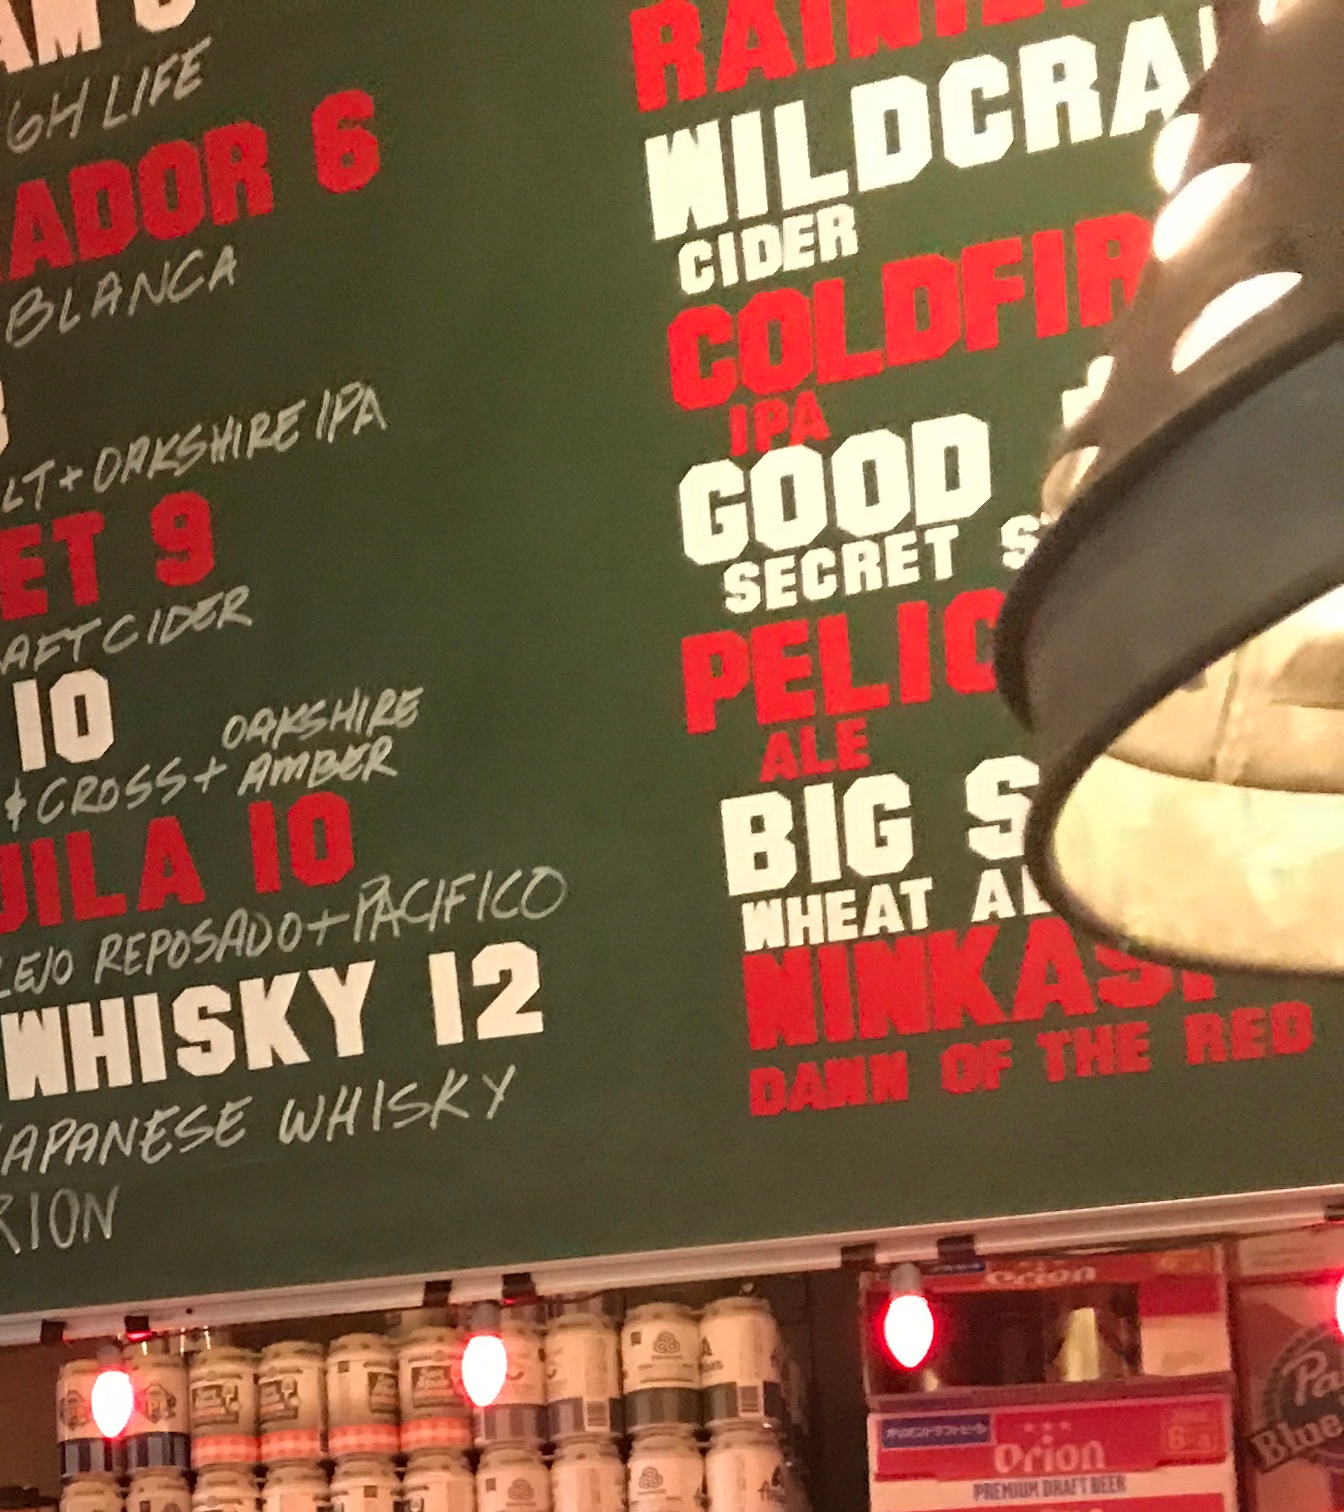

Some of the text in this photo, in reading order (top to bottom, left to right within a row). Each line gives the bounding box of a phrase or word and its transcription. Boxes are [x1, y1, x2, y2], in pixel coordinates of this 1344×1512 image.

[102, 37, 214, 133] LIFE
[312, 87, 380, 196] 6
[2, 244, 238, 348] BLANCA
[677, 203, 859, 296] CIDER
[666, 212, 1155, 412] COLDFIR
[92, 398, 309, 495] OAKSHIRE
[313, 379, 390, 445] IPA
[728, 390, 832, 457] IPA
[678, 412, 992, 566] GOOD
[148, 489, 218, 590] 9
[722, 523, 960, 615] SECRET
[101, 585, 255, 656] CIDER
[681, 587, 1007, 735] PELIC
[12, 668, 116, 774] 10
[221, 685, 425, 753] OAKSHIRE
[759, 717, 871, 783] ALE
[36, 756, 193, 825] CROSS
[237, 733, 400, 801] AMBER
[248, 790, 356, 896] 10
[720, 772, 914, 896] BIG
[93, 907, 309, 987] REPOSADO
[351, 864, 570, 945] PACIFICO
[742, 877, 934, 952] WHEAT
[1, 960, 378, 1105] WHISKY
[429, 939, 546, 1047] 12
[939, 1038, 1013, 1096] OF
[1037, 1021, 1151, 1084] THE
[1184, 1001, 1314, 1066] RED
[277, 1062, 521, 1147] WHISKY
[993, 1433, 1108, 1475] Orion
